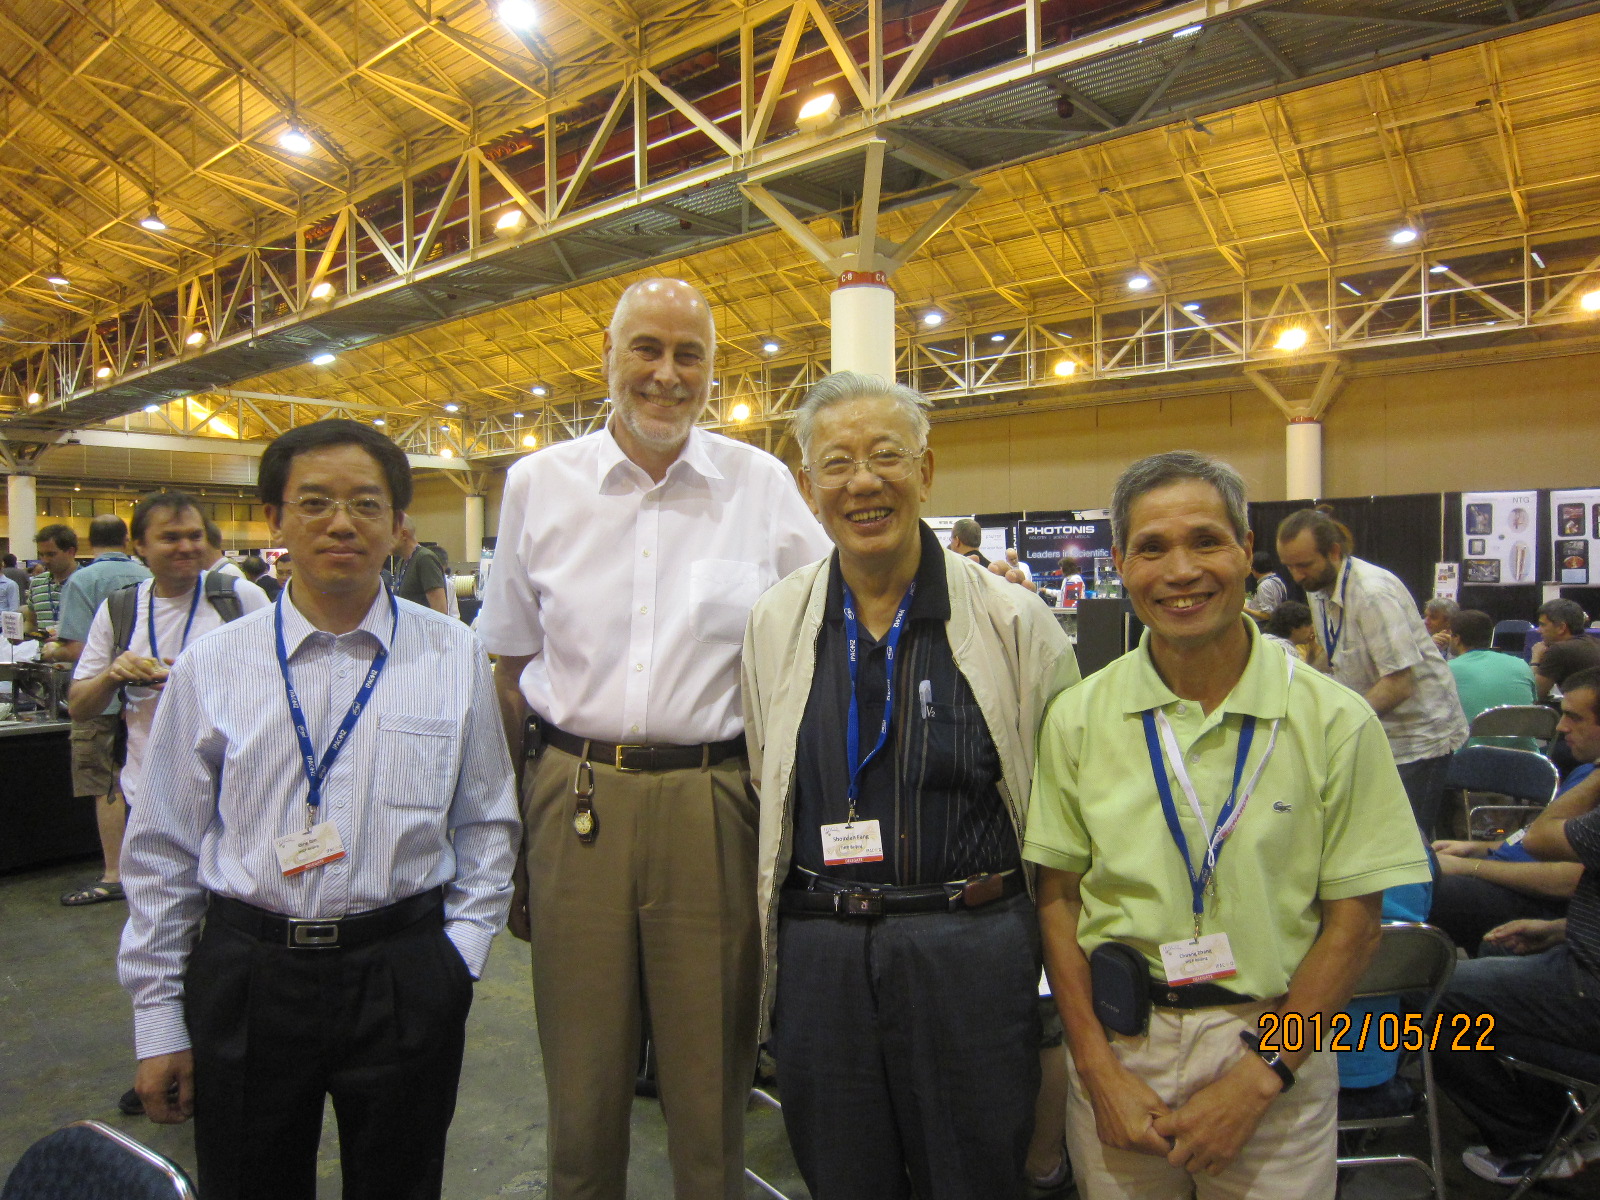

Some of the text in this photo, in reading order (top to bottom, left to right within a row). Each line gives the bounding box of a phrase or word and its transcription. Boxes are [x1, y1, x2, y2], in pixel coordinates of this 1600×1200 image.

[1512, 496, 1530, 504] NTG
[1025, 525, 1095, 535] PHOTONIS
[1026, 550, 1060, 559] Leaders
